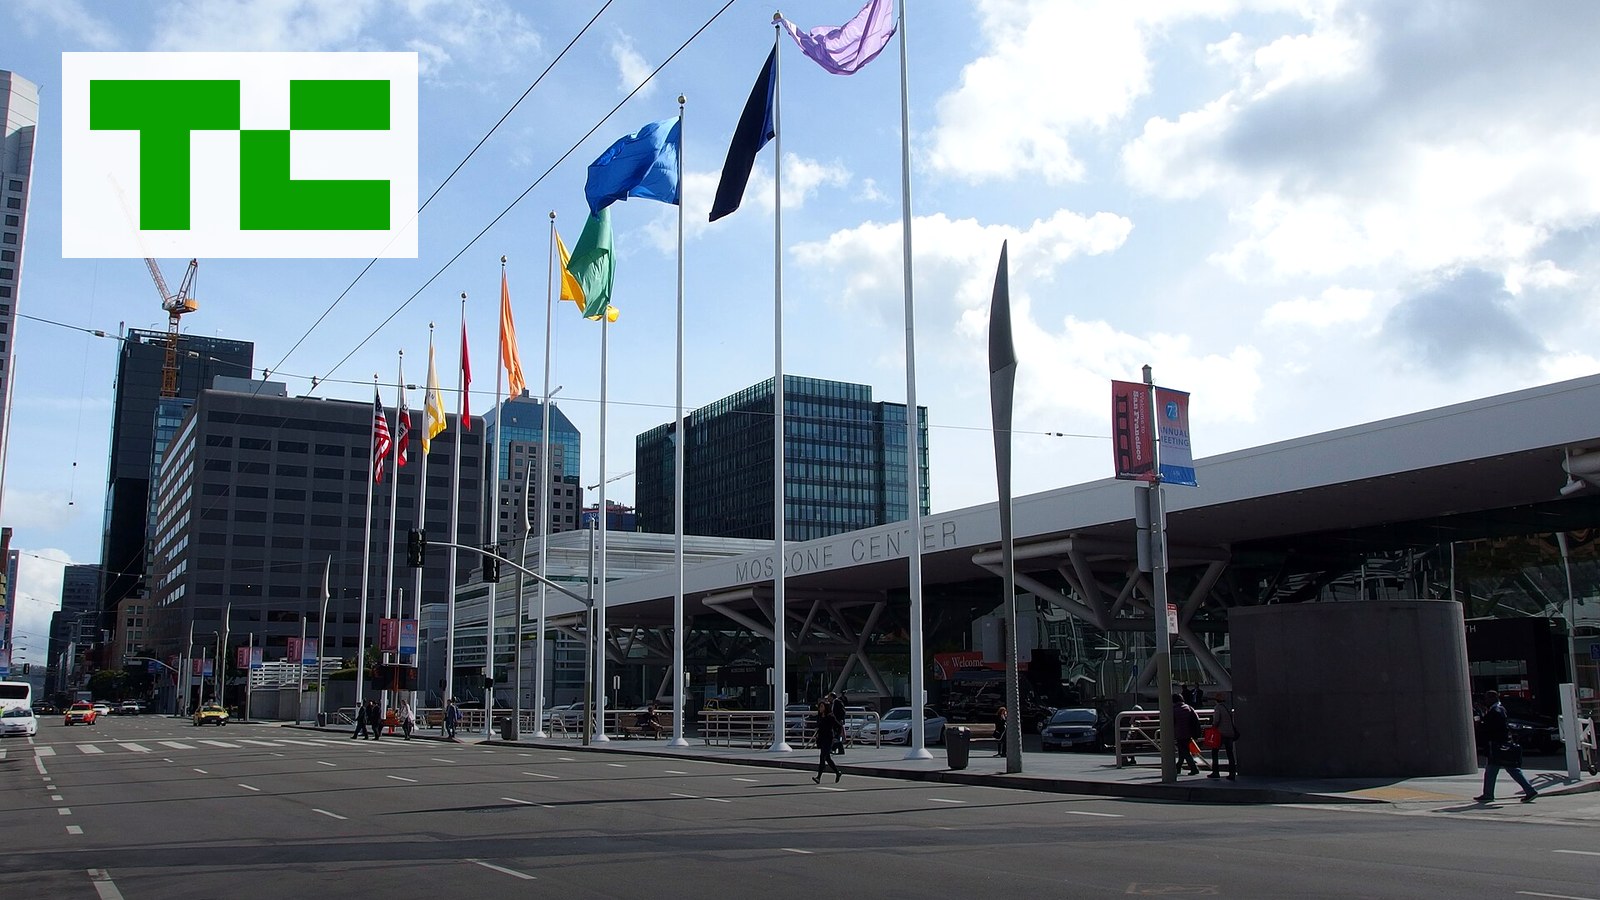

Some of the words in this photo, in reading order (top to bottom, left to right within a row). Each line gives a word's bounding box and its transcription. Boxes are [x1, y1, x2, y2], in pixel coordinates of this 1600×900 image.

[1134, 411, 1142, 461] Francisco
[735, 545, 833, 583] MOSONE
[951, 655, 984, 669] Welcome
